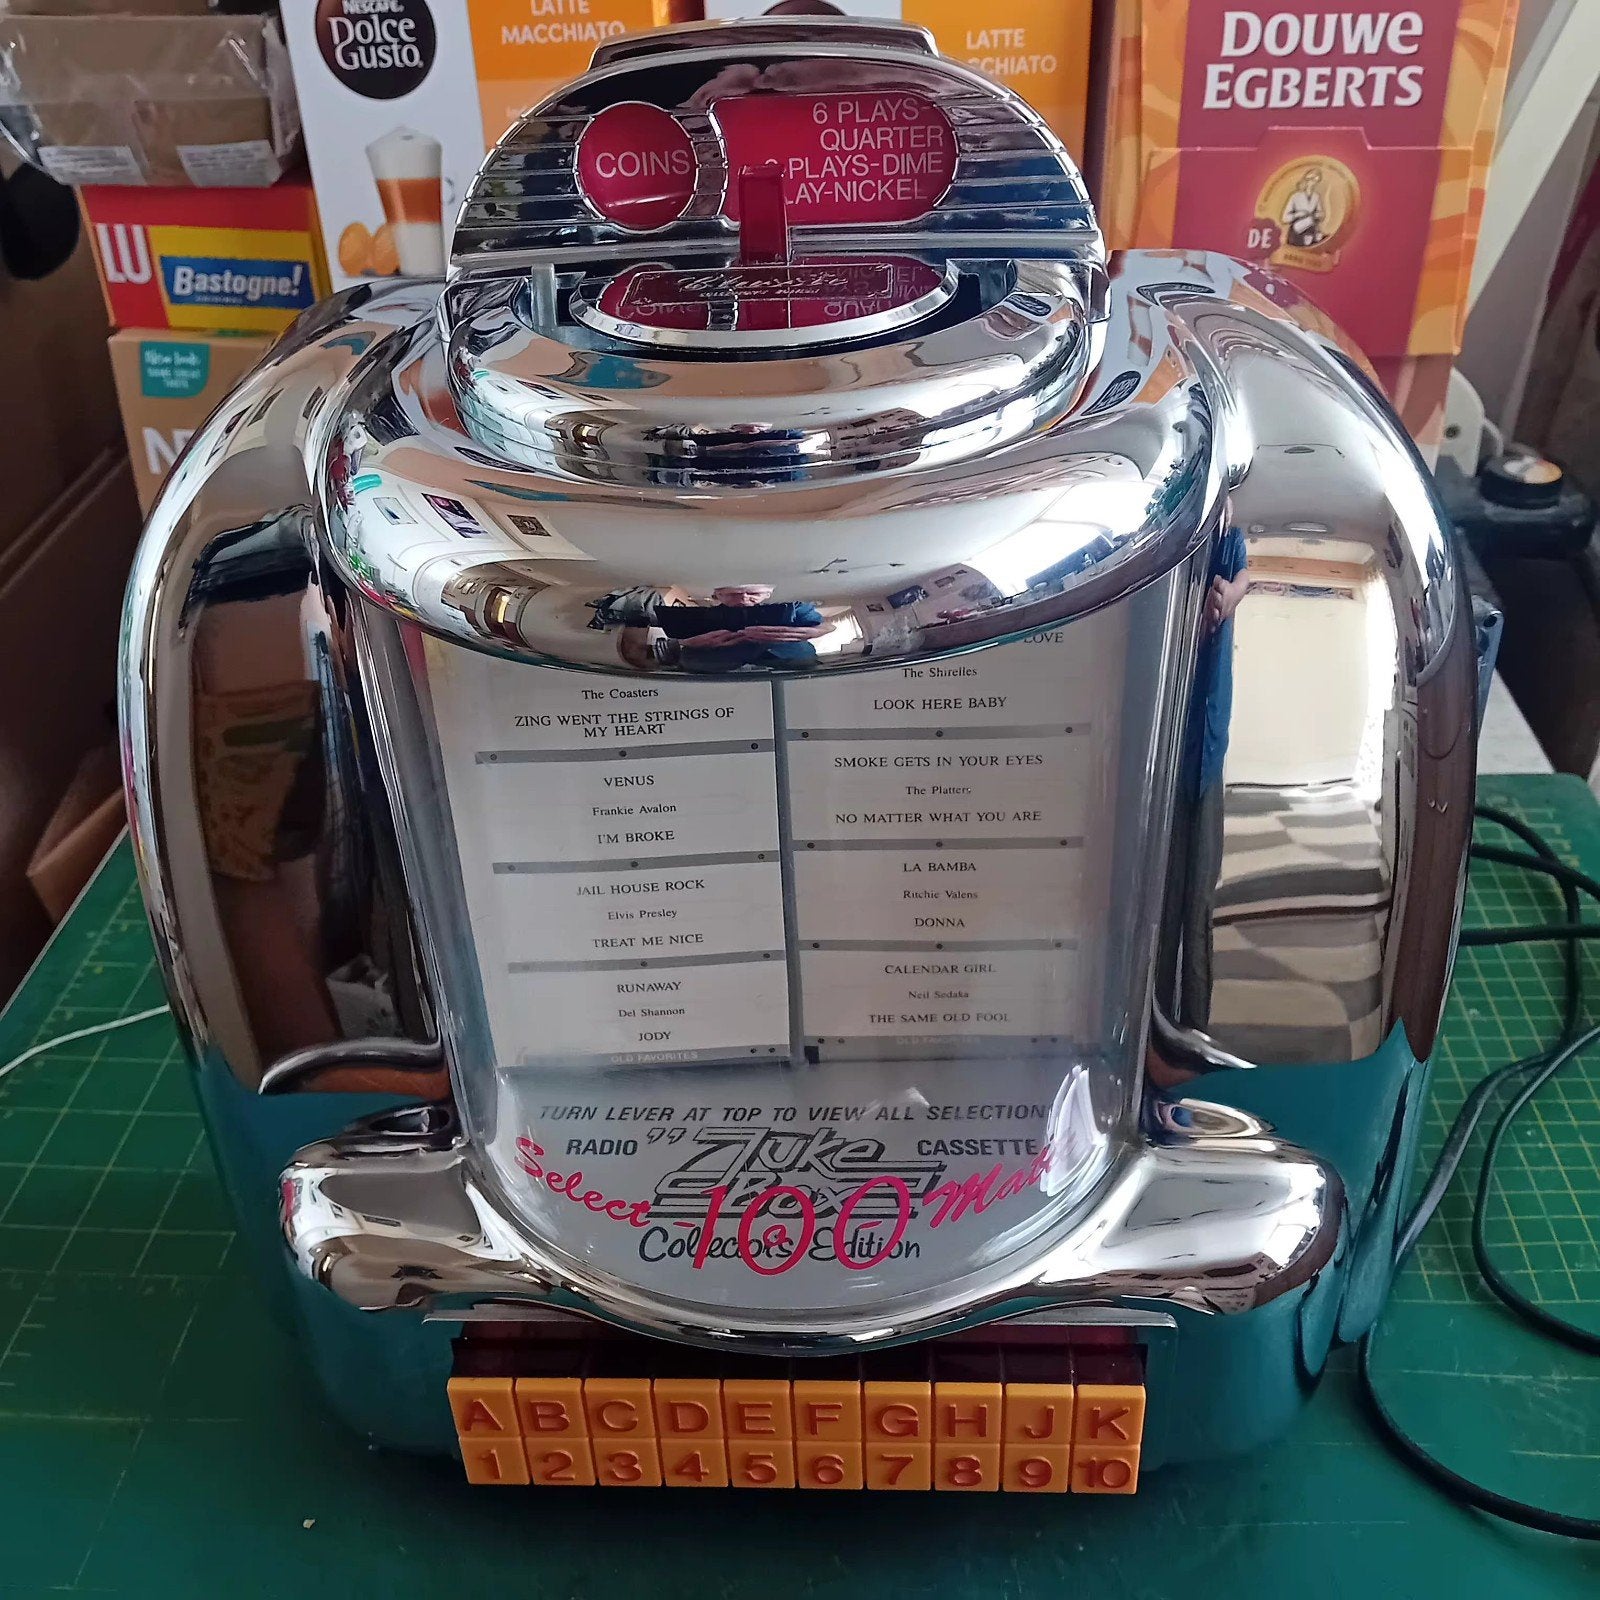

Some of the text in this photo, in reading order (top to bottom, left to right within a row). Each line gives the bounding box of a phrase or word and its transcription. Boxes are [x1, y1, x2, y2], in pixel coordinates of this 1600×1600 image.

[530, 0, 590, 16] LATTE
[327, 14, 417, 44] Dolce
[502, 20, 626, 45] MACCHIATO
[966, 28, 1026, 50] LATTE
[335, 43, 421, 70] Gusto
[967, 55, 1057, 76] CHIATO
[1203, 63, 1424, 109] EGBERTS
[812, 101, 828, 125] 6
[820, 125, 944, 152] QUARTER
[596, 149, 690, 178] COINS
[1247, 228, 1273, 249] DE
[96, 222, 152, 285] LU
[173, 264, 303, 301] Bastogne!
[903, 666, 978, 678] The Shirelles
[582, 688, 659, 700] The Coasters
[874, 696, 1007, 711] LOOK HERE BABY
[515, 707, 735, 727] ZING WENT THE STRINGS OF
[584, 724, 666, 738] MY HEART
[834, 755, 1043, 768] SMOKE GETS IN YOUR EYES
[603, 775, 655, 788] VENUS
[905, 786, 926, 795] The
[592, 803, 677, 816] Frankie Avalon
[836, 810, 1042, 824] NO MATTER WHAT YOU ARE
[597, 831, 675, 845] I'M BROKE
[903, 862, 977, 872] LA BAMBA
[576, 879, 705, 896] JAIL HOUSE ROCK
[903, 890, 978, 899] Ritchie Valens
[608, 909, 678, 921] Elvis Presley
[915, 917, 965, 928] DONNA
[593, 934, 704, 949] TREAT ME NICE
[885, 964, 996, 975] CALENDAR GIRL
[616, 981, 682, 993] RUNAWAY
[908, 990, 969, 999] Neil Sedaka
[618, 1006, 685, 1018] Del Shannon
[869, 1012, 1010, 1023] THE SAME OLD FOOL
[638, 1031, 672, 1042] JODY
[540, 1104, 1054, 1121] TURN LEVER AT TOP TO VIEW ALL SELECTION
[566, 1139, 638, 1156] RADIO
[918, 1139, 1038, 1156] CASSETTE
[514, 1136, 650, 1228] Select
[693, 1175, 911, 1275] 100
[464, 1399, 1131, 1440] A B C D E F G H J K
[481, 1449, 1132, 1489] 1 2 3 4 5 6 7 8 9 10
